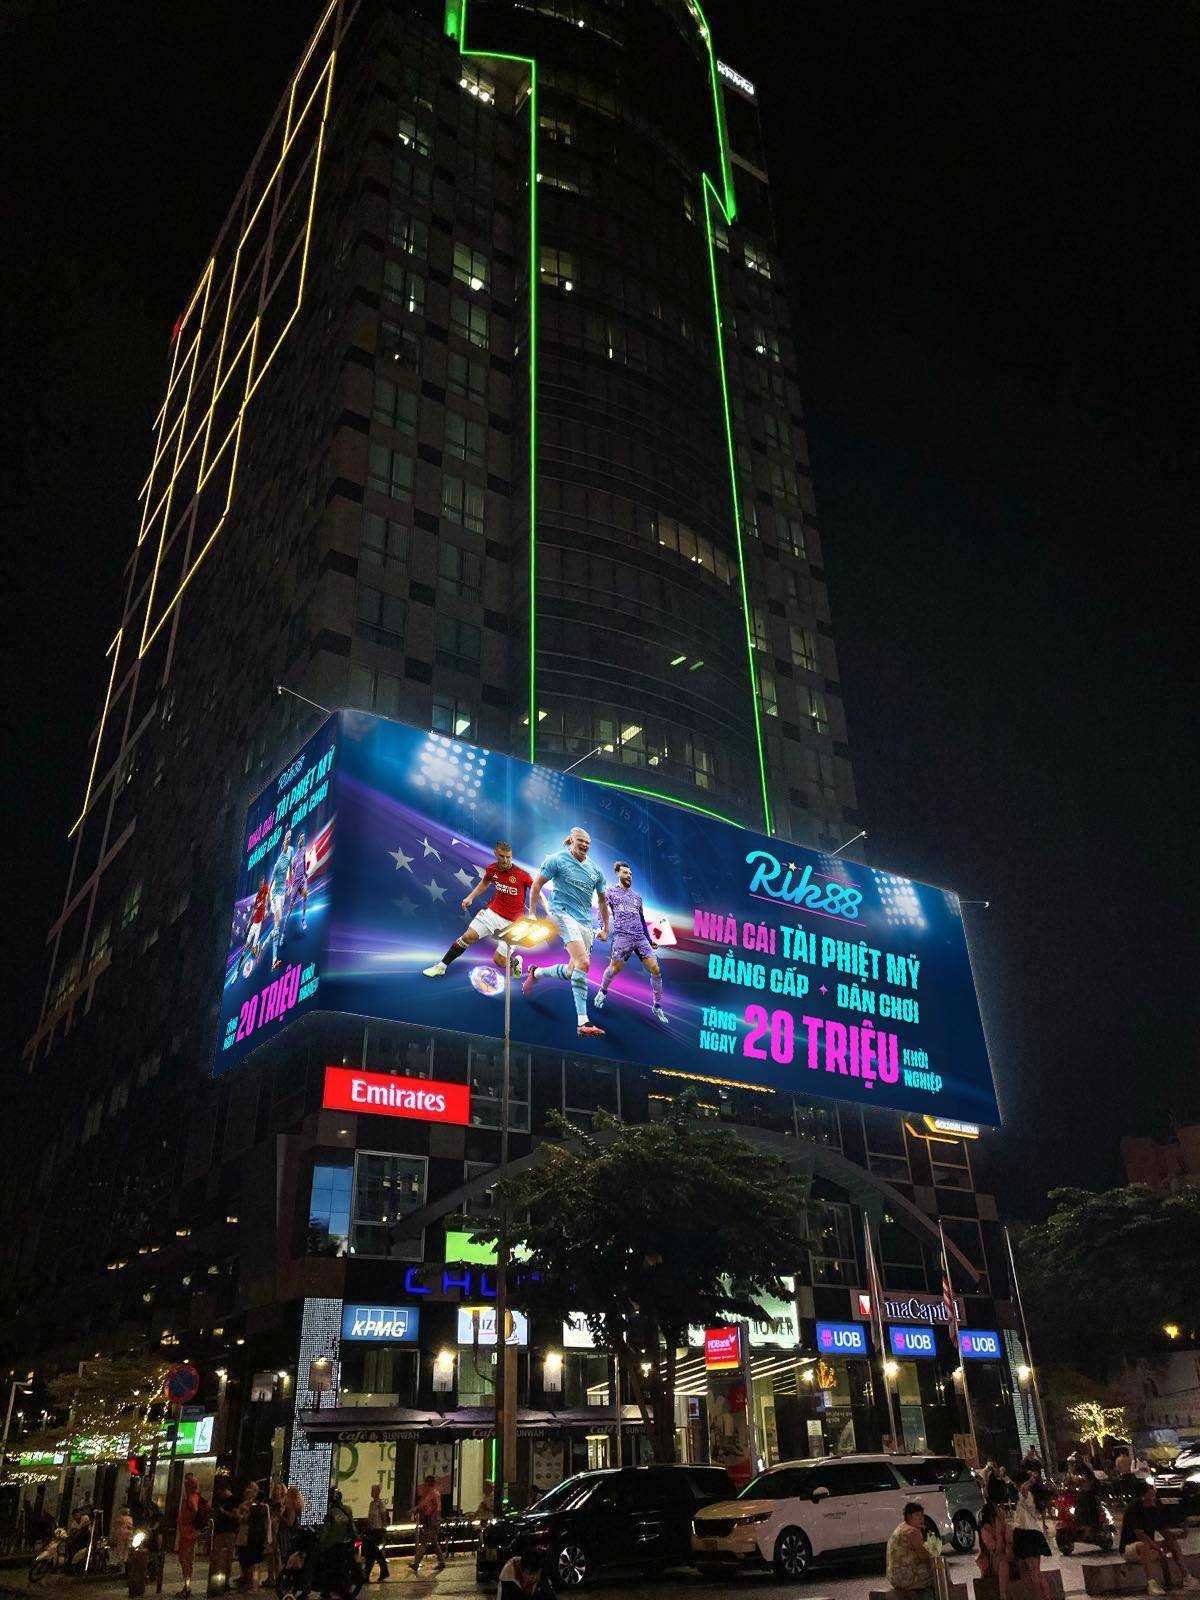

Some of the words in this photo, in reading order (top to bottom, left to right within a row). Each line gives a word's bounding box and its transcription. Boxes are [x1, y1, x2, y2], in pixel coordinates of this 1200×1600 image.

[745, 850, 863, 918] Rik88
[693, 909, 738, 946] NHÀ
[743, 921, 776, 956] CÁI
[780, 923, 817, 965] TÀI
[821, 936, 881, 982] PHIỆT
[886, 953, 920, 990] MỸ
[708, 949, 766, 990] ĐẲNG
[770, 967, 809, 998] CẤP
[837, 983, 877, 1015] DÂN
[879, 993, 919, 1024] CHƠI
[236, 994, 259, 1042] 20
[258, 963, 302, 1029] TRIỆU
[701, 1006, 737, 1031] TẶNG
[699, 1030, 738, 1054] NGAY
[743, 1003, 794, 1064] 20
[803, 1014, 899, 1089] TRIỆU
[352, 1078, 446, 1112] Emirates
[351, 1320, 405, 1338] KPMG
[833, 1331, 862, 1348] UOB
[905, 1334, 932, 1350] UOB
[971, 1337, 996, 1352] UOB
[516, 1429, 545, 1439] UNWAH
